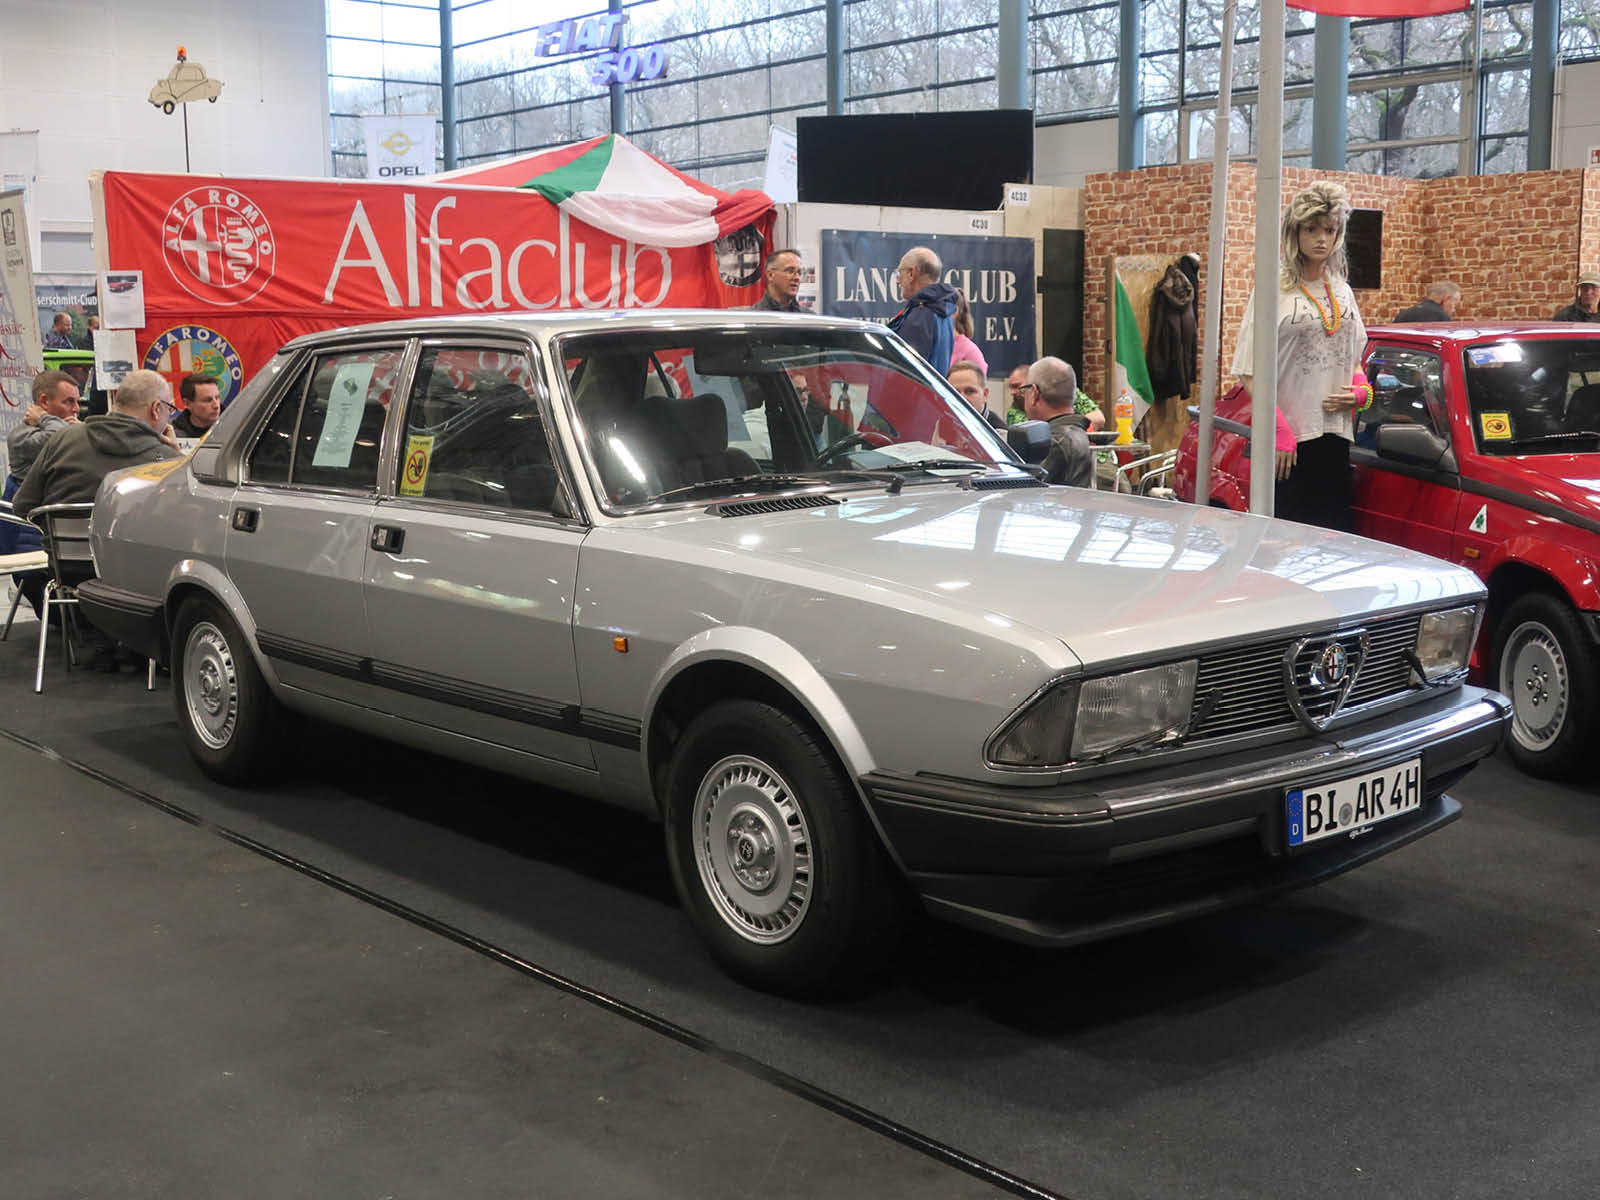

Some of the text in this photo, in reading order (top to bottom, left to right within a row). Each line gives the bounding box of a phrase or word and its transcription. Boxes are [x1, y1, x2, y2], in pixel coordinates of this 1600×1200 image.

[534, 13, 627, 57] FIAT
[592, 43, 667, 85] 500
[378, 166, 424, 176] OPEL
[1010, 191, 1027, 202] 4C32
[165, 190, 273, 255] ALFA ROMEO
[322, 193, 672, 310] Alfaclub
[36, 293, 98, 305] serschmitt-Club
[835, 266, 1017, 304] LANC CLUB
[985, 317, 1018, 341] E.V.
[1306, 765, 1419, 836] BI AR 4H
[1292, 823, 1300, 836] D
